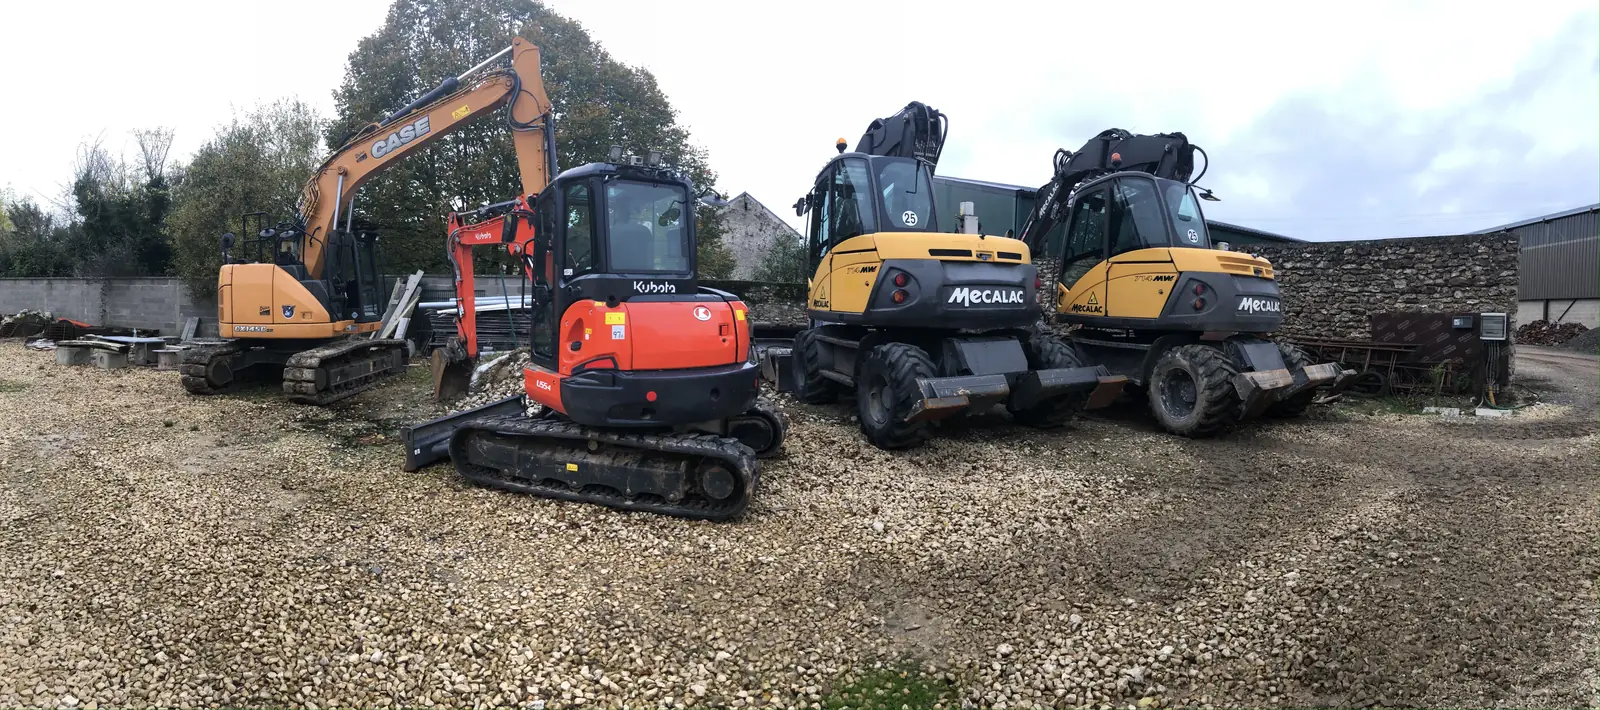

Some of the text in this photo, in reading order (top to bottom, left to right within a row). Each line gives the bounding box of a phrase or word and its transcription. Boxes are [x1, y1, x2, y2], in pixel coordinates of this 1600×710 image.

[371, 115, 430, 159] CASE
[904, 213, 916, 224] 25
[1189, 230, 1198, 241] 25
[633, 281, 676, 293] Kubota
